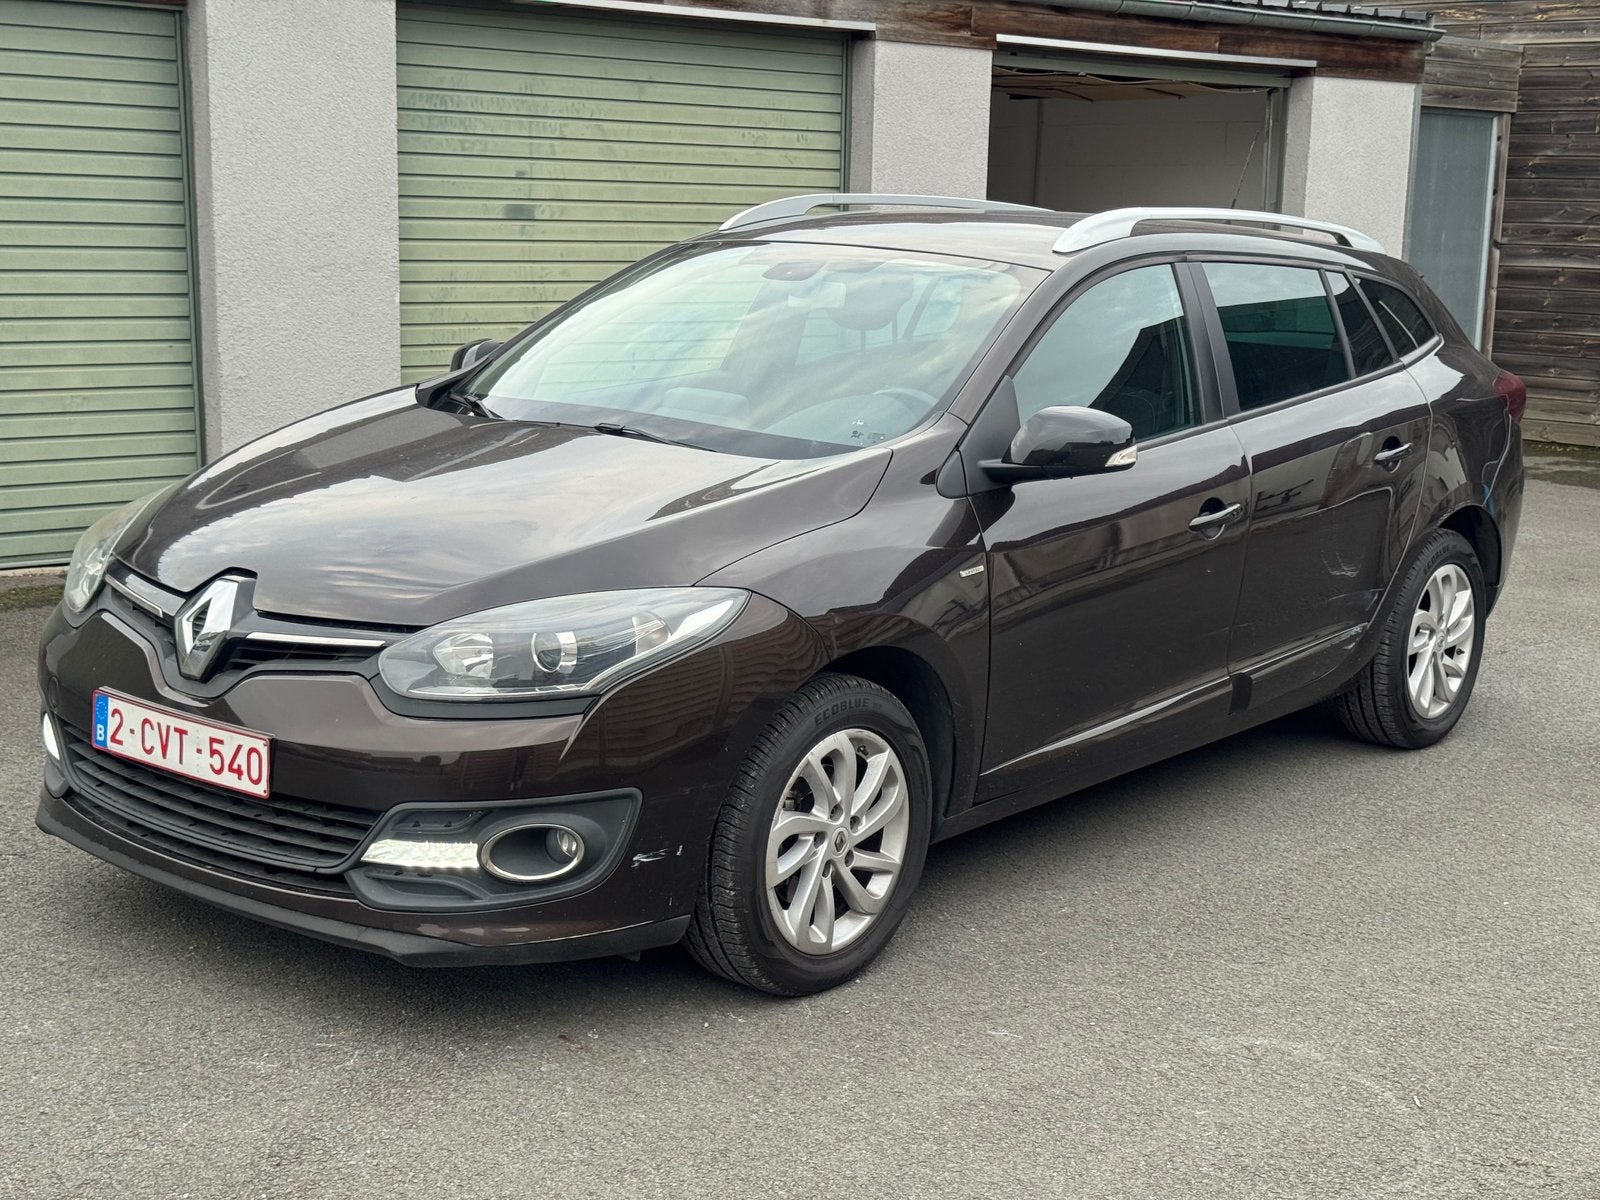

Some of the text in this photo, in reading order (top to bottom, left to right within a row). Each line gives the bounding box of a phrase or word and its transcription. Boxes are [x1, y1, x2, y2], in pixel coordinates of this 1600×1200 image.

[814, 697, 871, 727] ECOBLUE
[96, 707, 263, 785] B 2-CVT-540
